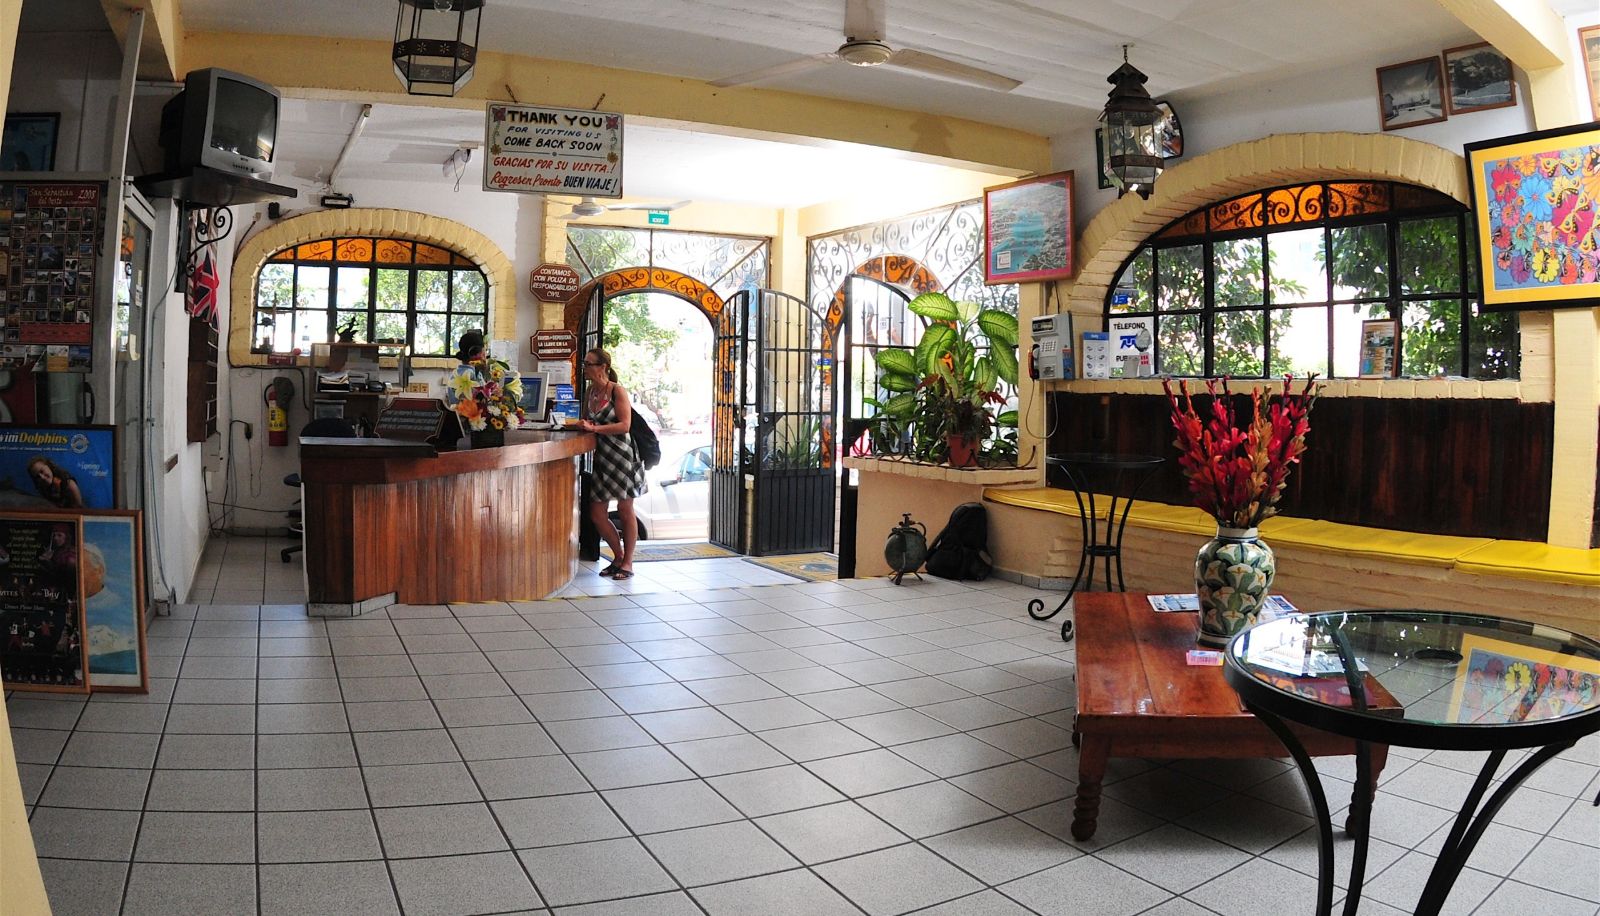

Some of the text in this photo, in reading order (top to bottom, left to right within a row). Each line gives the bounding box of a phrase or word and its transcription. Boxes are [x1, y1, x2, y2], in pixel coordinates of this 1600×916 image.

[507, 110, 603, 128] THANK YOU
[535, 128, 582, 137] VISITING
[503, 136, 603, 151] COME BACK SOON
[493, 156, 534, 168] GRACIAS
[535, 159, 551, 169] POR
[554, 160, 569, 171] SU
[490, 171, 533, 189] Regresen
[533, 173, 562, 187] Pronto
[563, 175, 585, 188] BUEN
[540, 268, 572, 277] CONTAMOS
[547, 276, 567, 284] POLIZA
